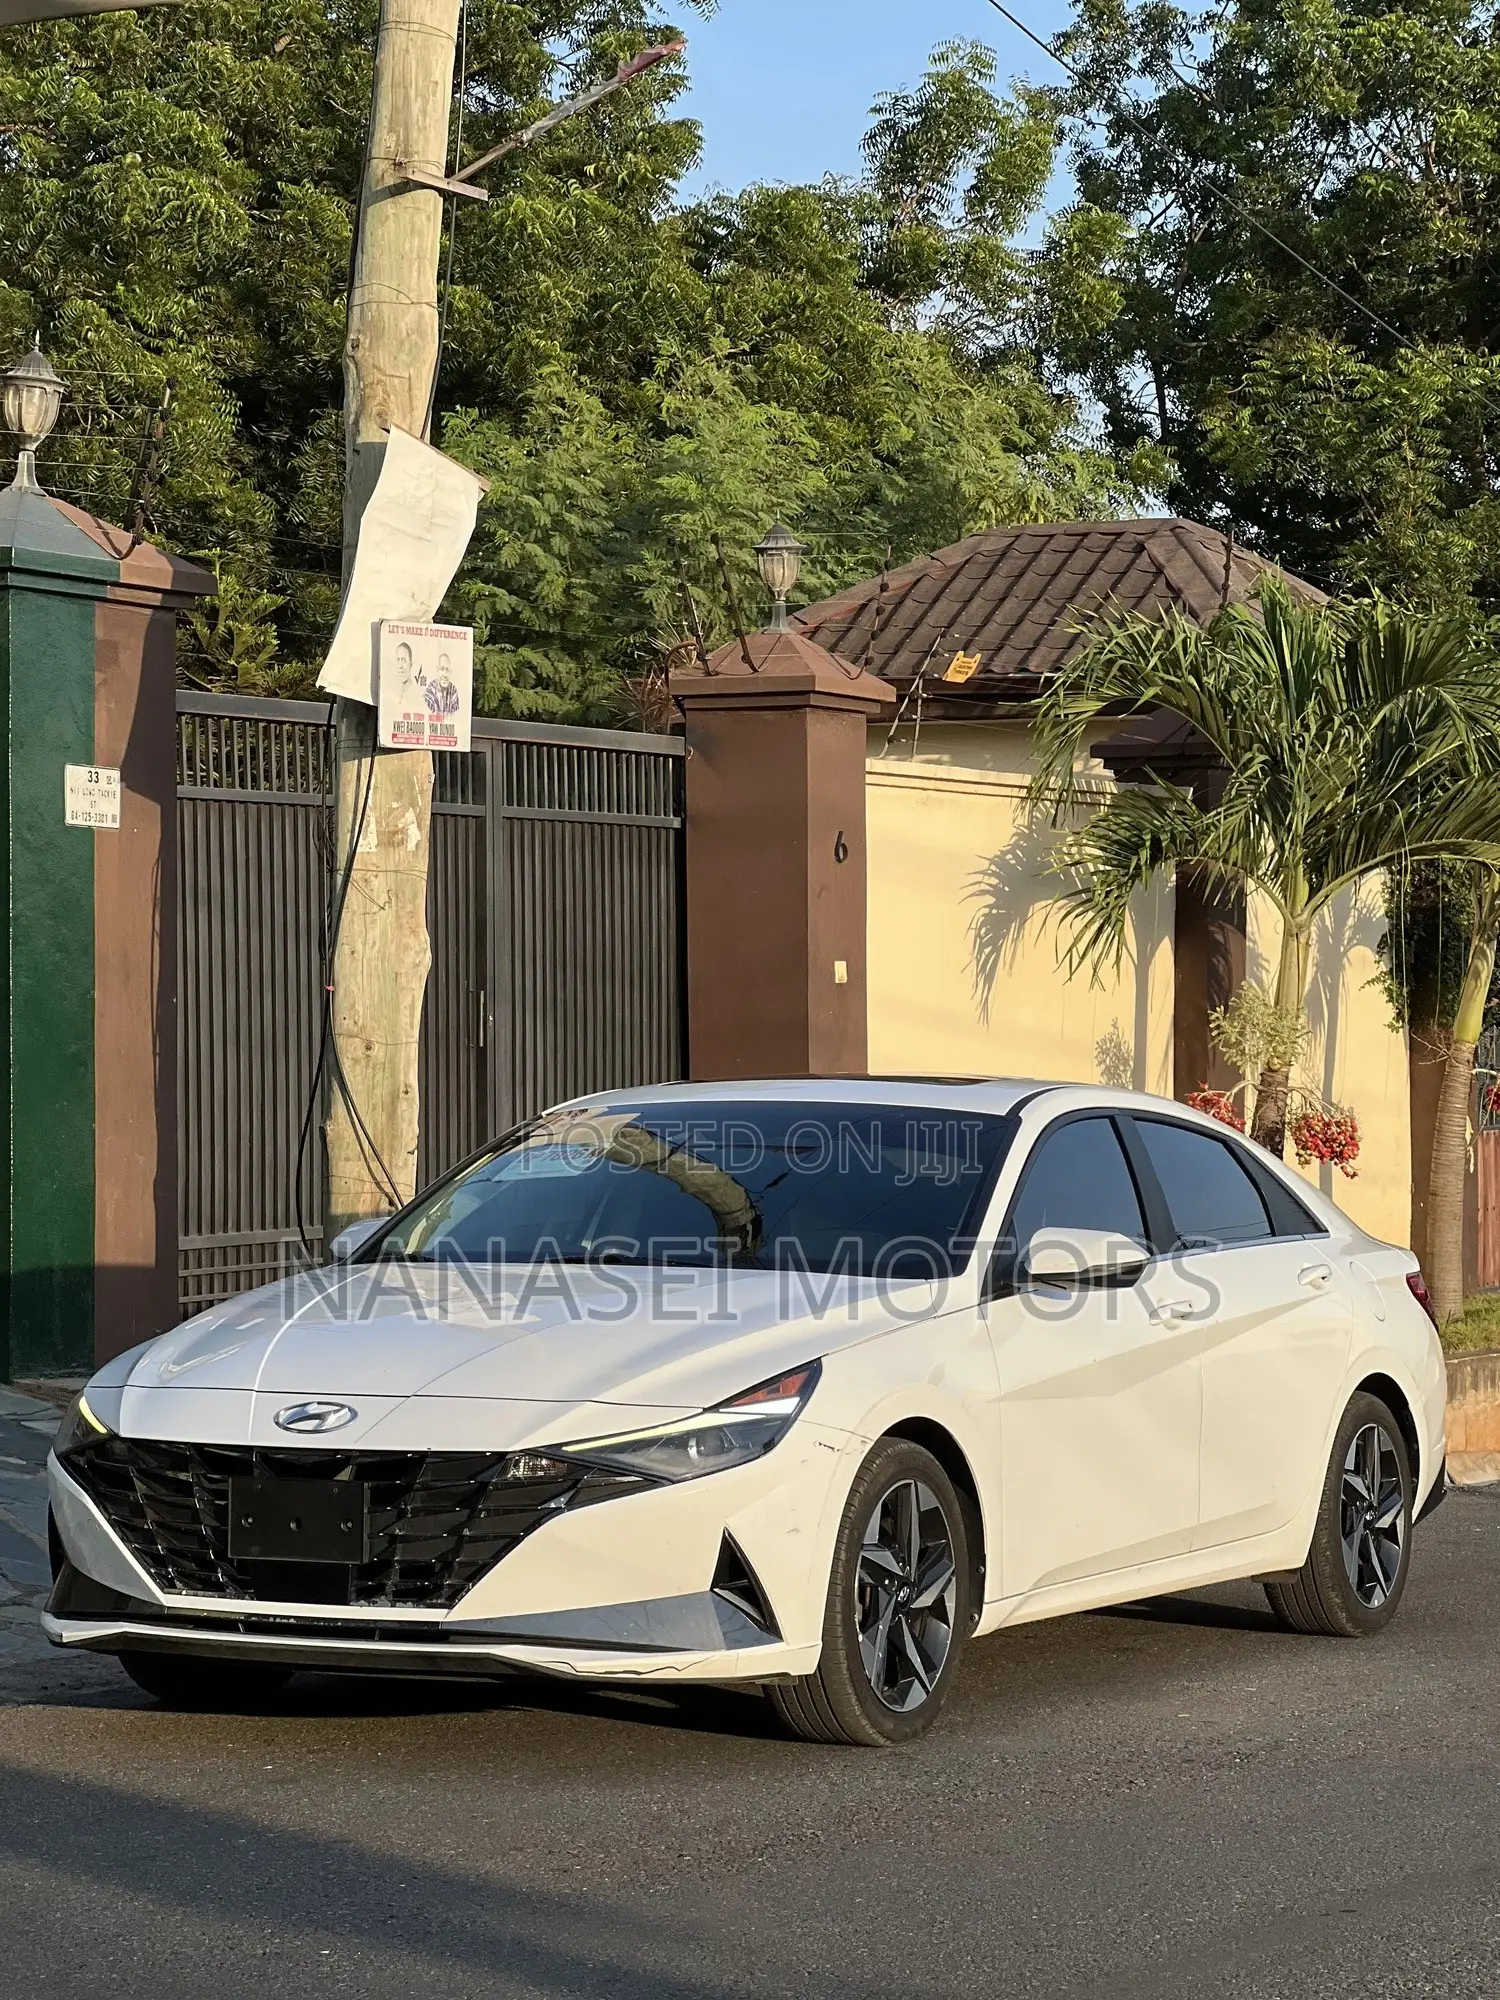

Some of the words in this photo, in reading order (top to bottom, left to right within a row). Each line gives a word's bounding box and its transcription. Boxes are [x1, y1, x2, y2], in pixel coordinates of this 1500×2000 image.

[388, 624, 405, 634] LET'S
[405, 626, 423, 636] MAKE
[429, 628, 468, 640] DIFFERENCE
[87, 770, 100, 784] 33
[834, 830, 849, 864] 6
